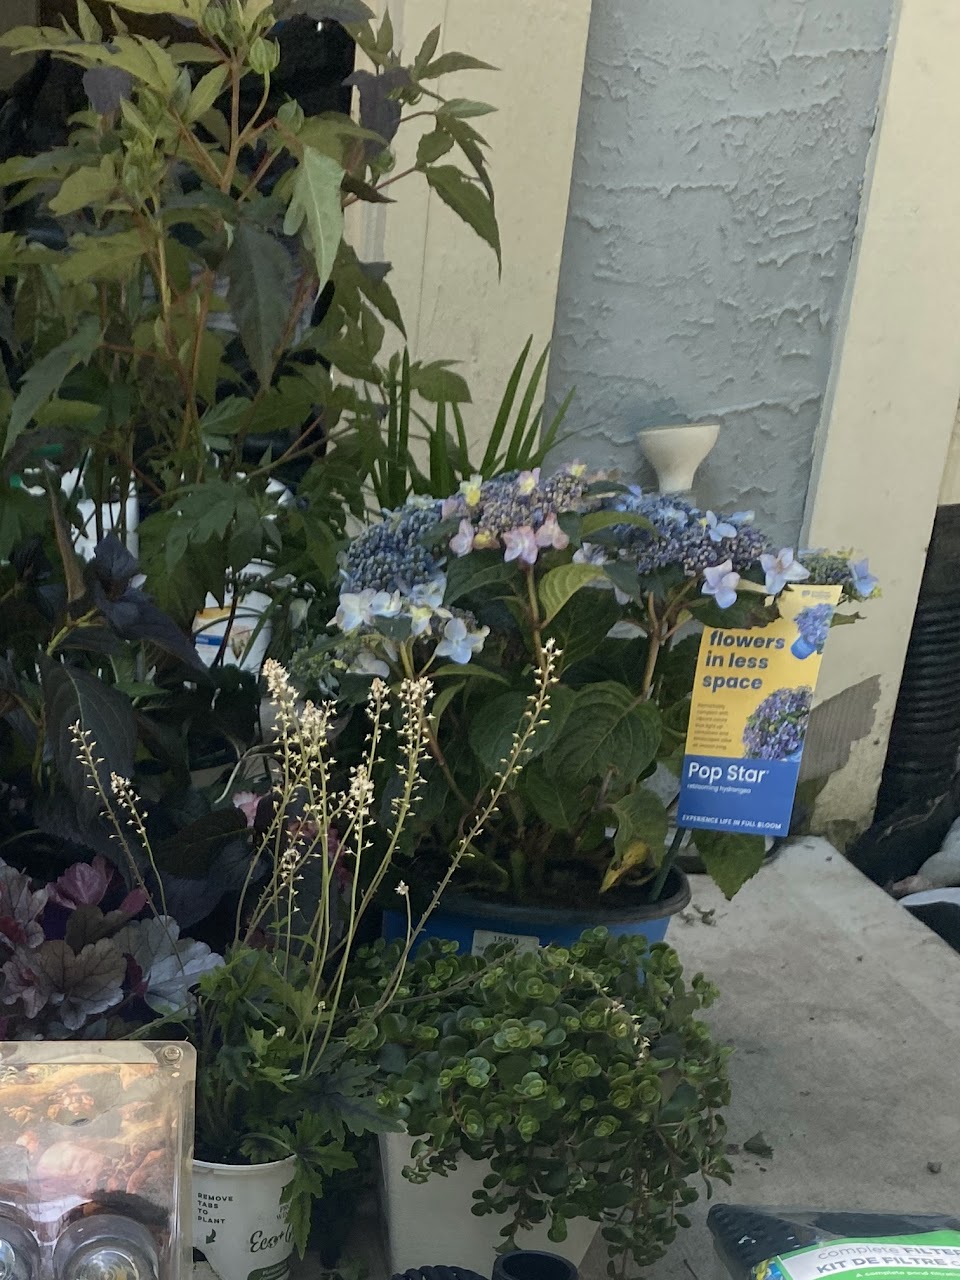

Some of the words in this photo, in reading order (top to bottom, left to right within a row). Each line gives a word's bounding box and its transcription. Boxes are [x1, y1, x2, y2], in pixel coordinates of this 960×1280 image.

[709, 629, 786, 650] flowers
[705, 650, 724, 667] in
[728, 652, 769, 669] less
[702, 675, 763, 693] space
[688, 761, 722, 785] Pop
[682, 814, 719, 825] EXPERIENCE
[740, 819, 756, 828] FULL
[757, 821, 782, 830] BLOOM
[197, 1192, 233, 1201] REMOVE
[197, 1200, 219, 1209] TABS
[197, 1215, 226, 1224] PLANT
[818, 1245, 900, 1260] complete
[816, 1260, 847, 1274] KIT
[851, 1256, 880, 1266] DE
[881, 1256, 948, 1266] FILTRE
